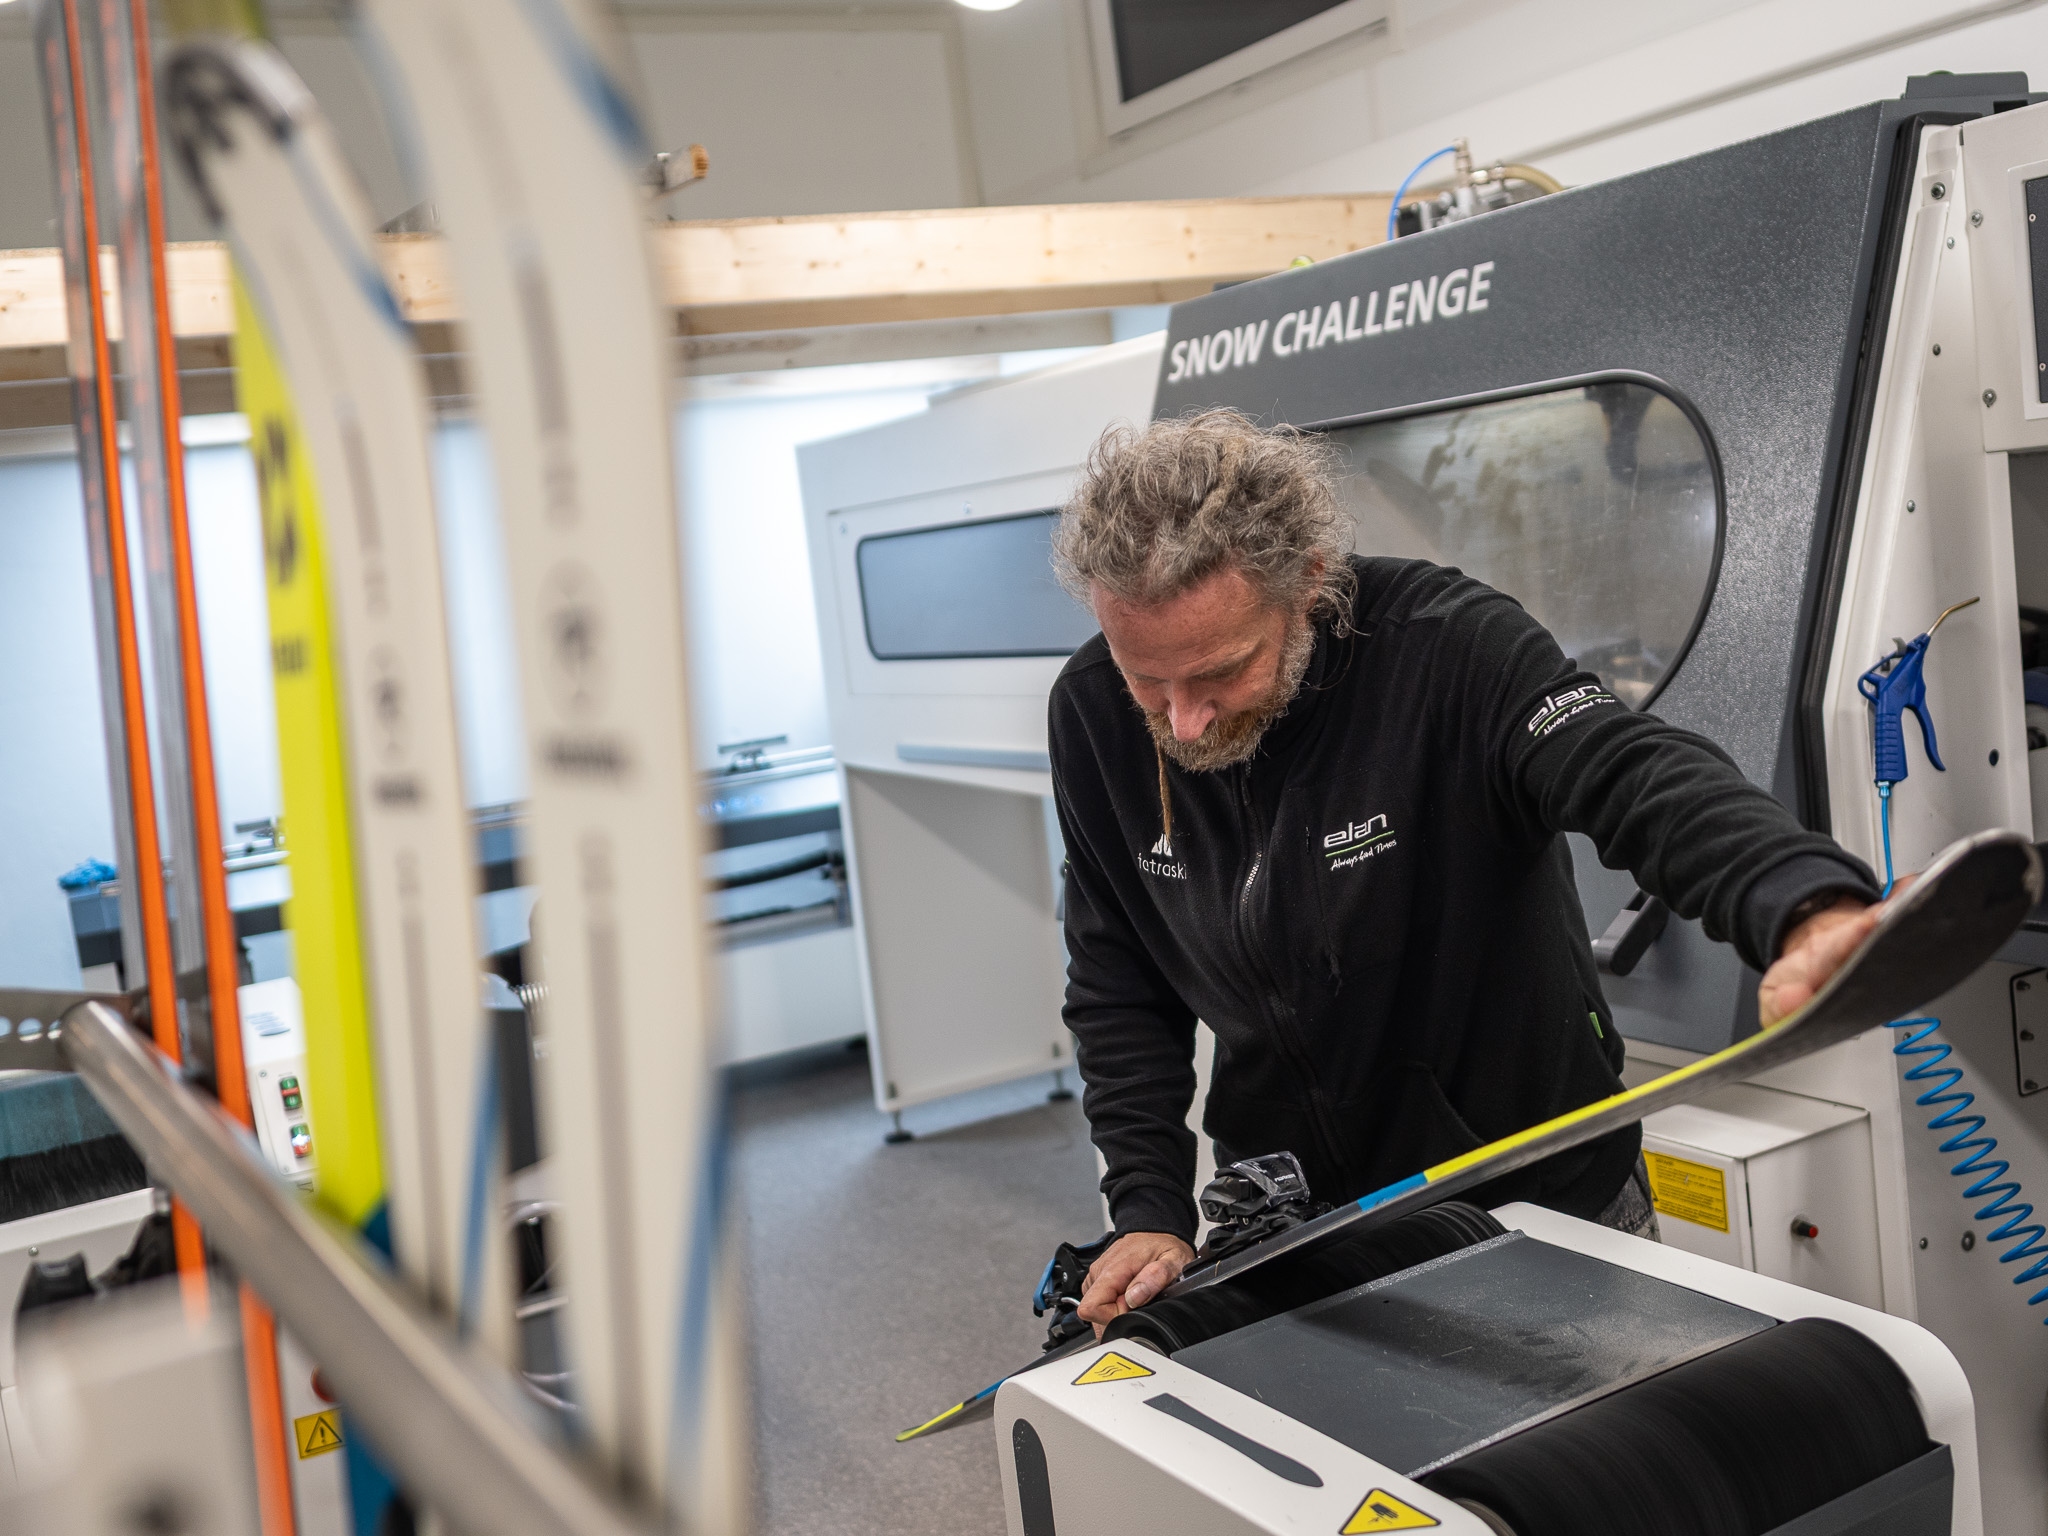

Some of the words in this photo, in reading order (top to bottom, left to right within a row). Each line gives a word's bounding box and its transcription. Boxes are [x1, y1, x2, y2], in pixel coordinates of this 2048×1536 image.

[1168, 319, 1269, 382] SNOW
[1272, 260, 1495, 356] CHALLENGE
[1528, 685, 1602, 732] elan
[1323, 813, 1388, 848] elan
[1330, 856, 1358, 872] Always
[1358, 846, 1375, 863] Good
[1374, 839, 1397, 854] Times
